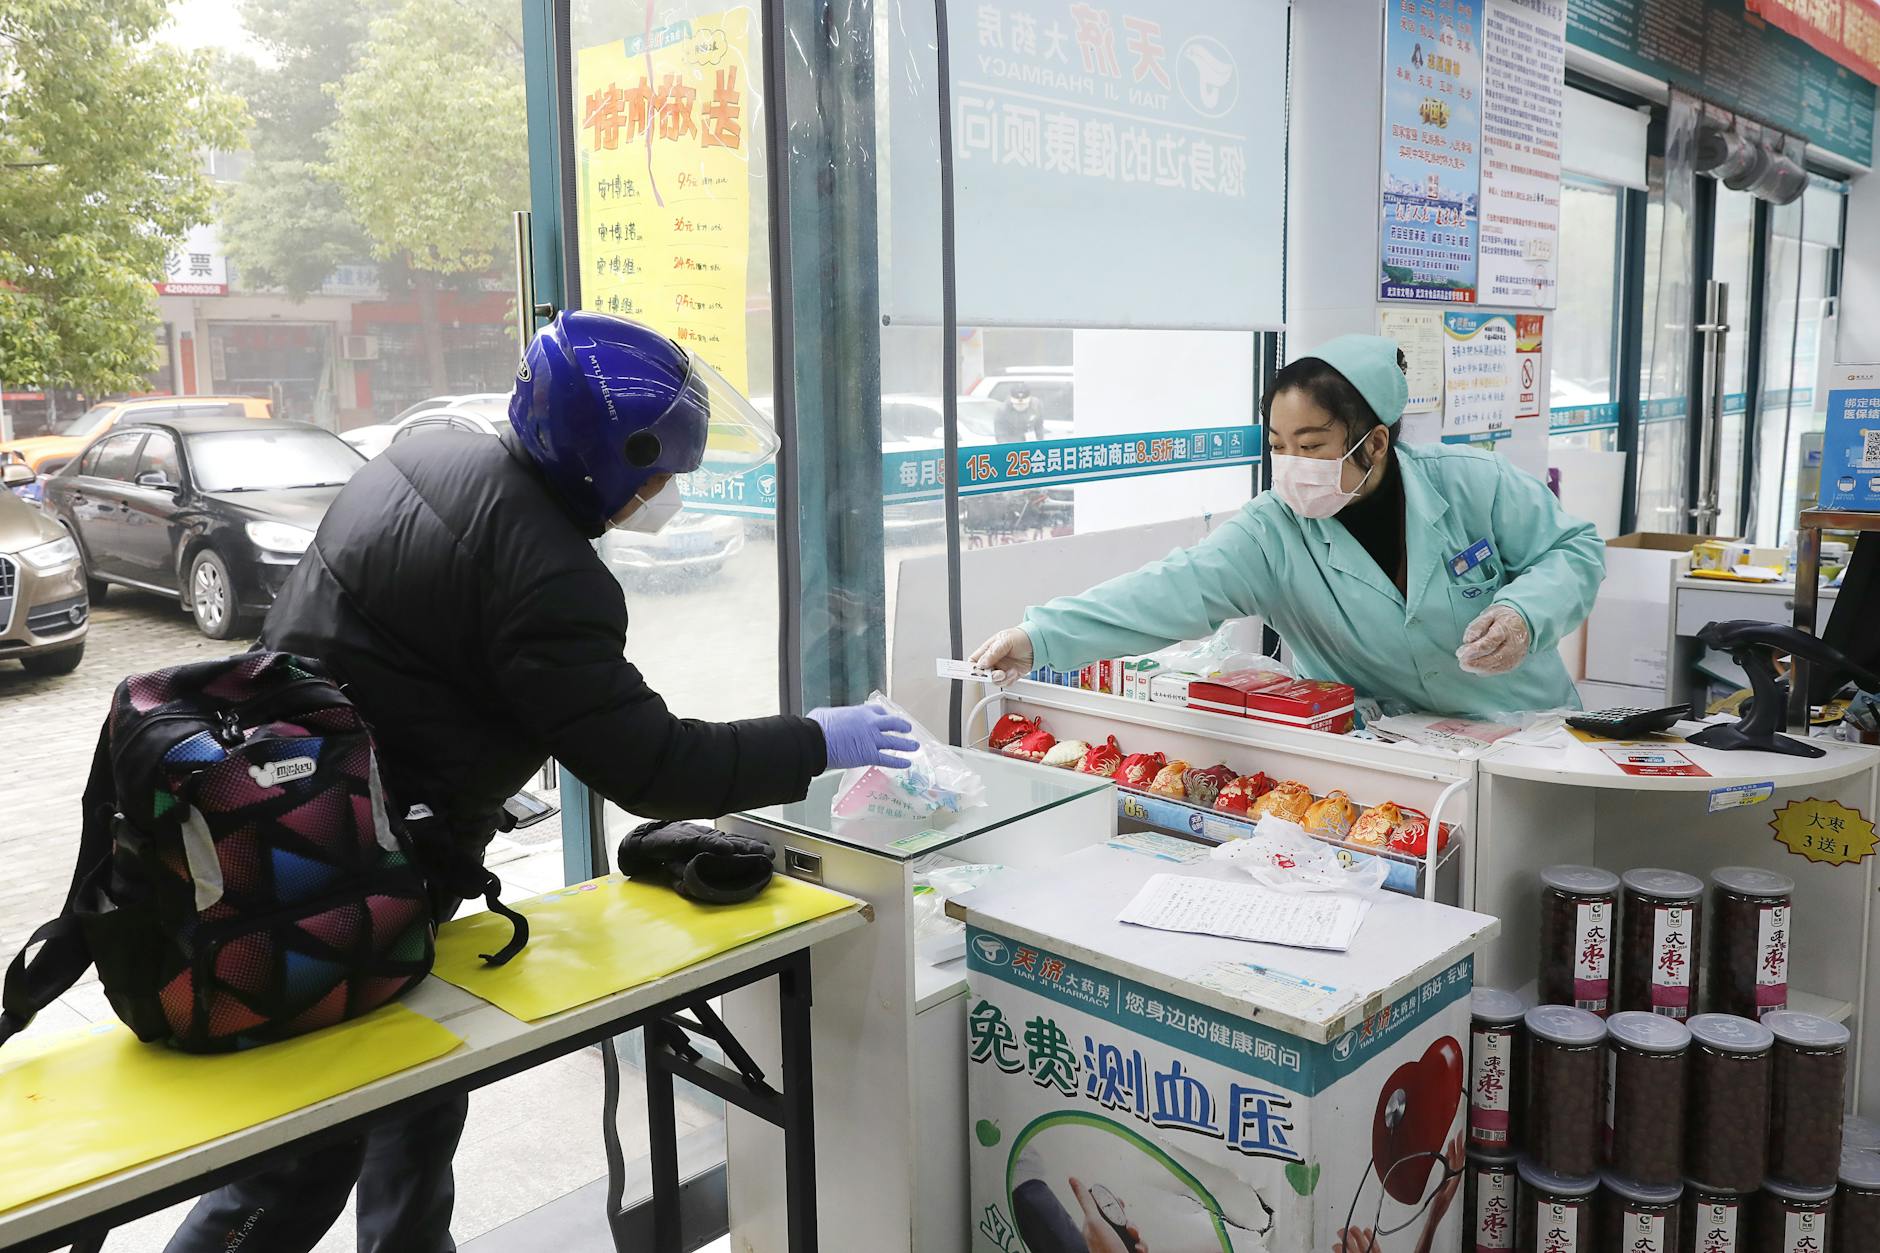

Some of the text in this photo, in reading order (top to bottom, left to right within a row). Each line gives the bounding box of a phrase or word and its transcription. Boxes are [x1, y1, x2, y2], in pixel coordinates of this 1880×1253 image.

[1805, 812, 1846, 833] 大枣
[1011, 967, 1109, 1008] TIAN JI PHARMACY
[1125, 990, 1301, 1072] 您身边的健康顾问
[970, 1000, 1304, 1162] 免费测血压
